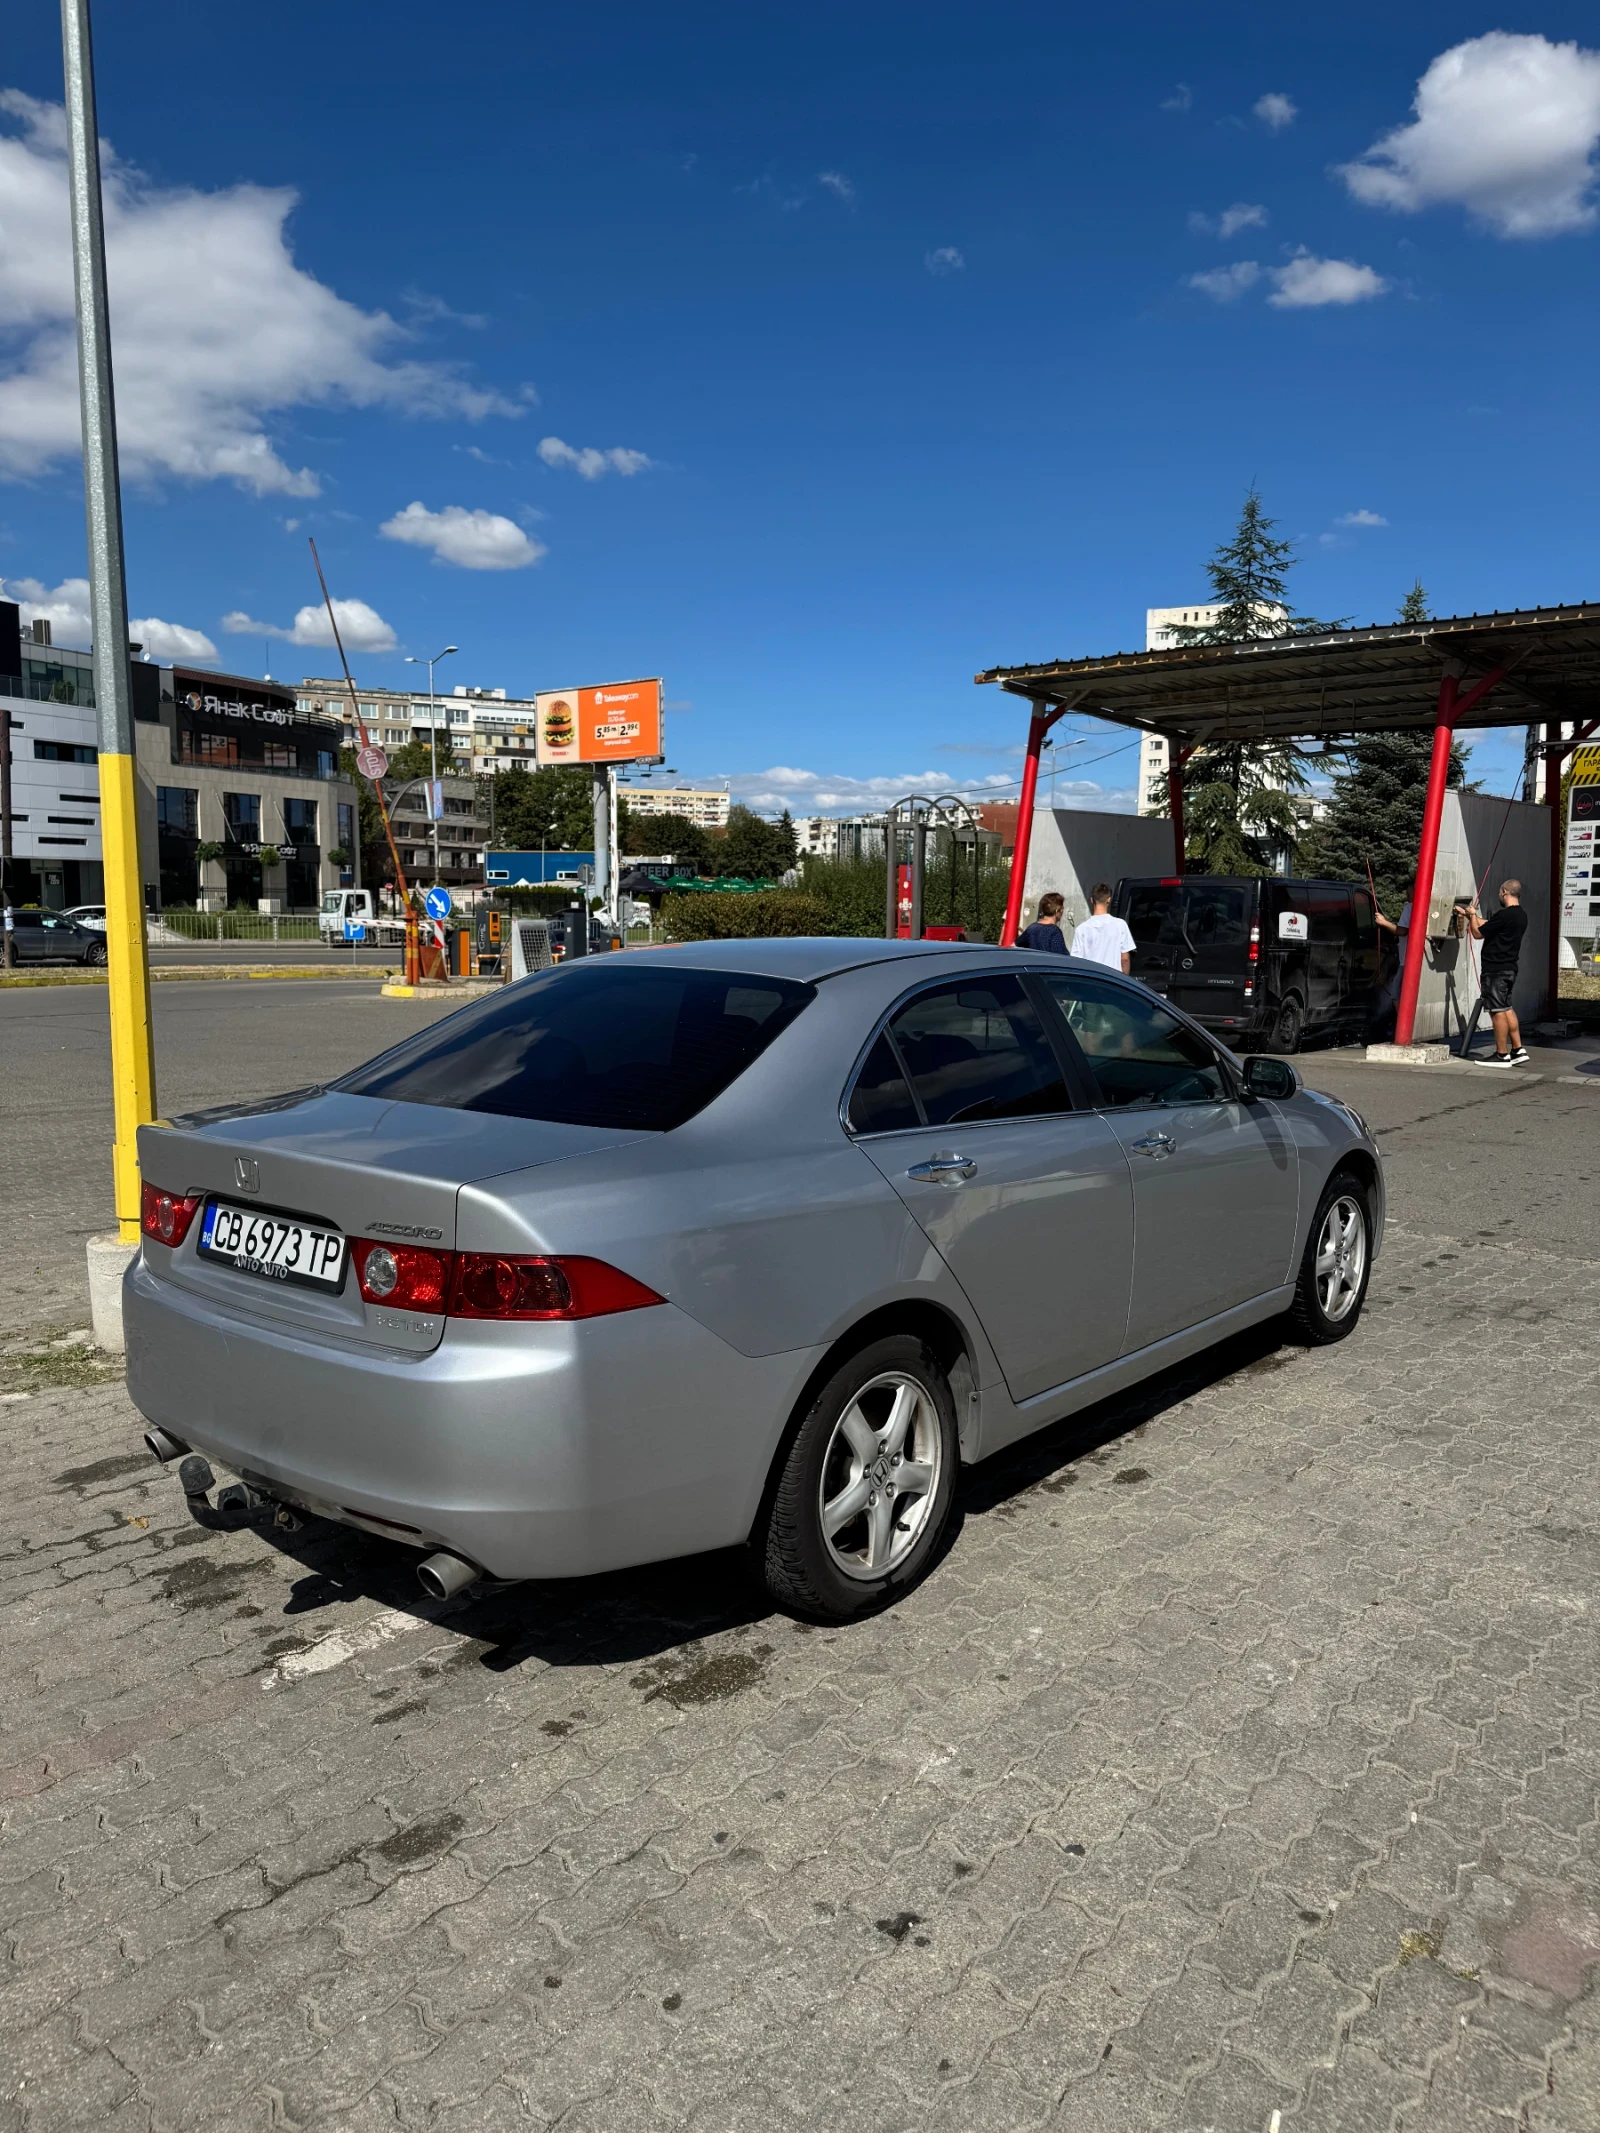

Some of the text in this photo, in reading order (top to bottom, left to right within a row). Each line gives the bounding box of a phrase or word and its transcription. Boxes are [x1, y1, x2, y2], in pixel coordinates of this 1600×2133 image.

[204, 696, 295, 726] Янак Софт
[365, 750, 382, 776] STOP
[674, 867, 692, 877] BOX
[202, 1231, 212, 1243] BG
[214, 1211, 341, 1275] CB 6973 TP
[365, 1222, 443, 1240] ACCORD
[233, 1254, 288, 1280] ANTO AUTO
